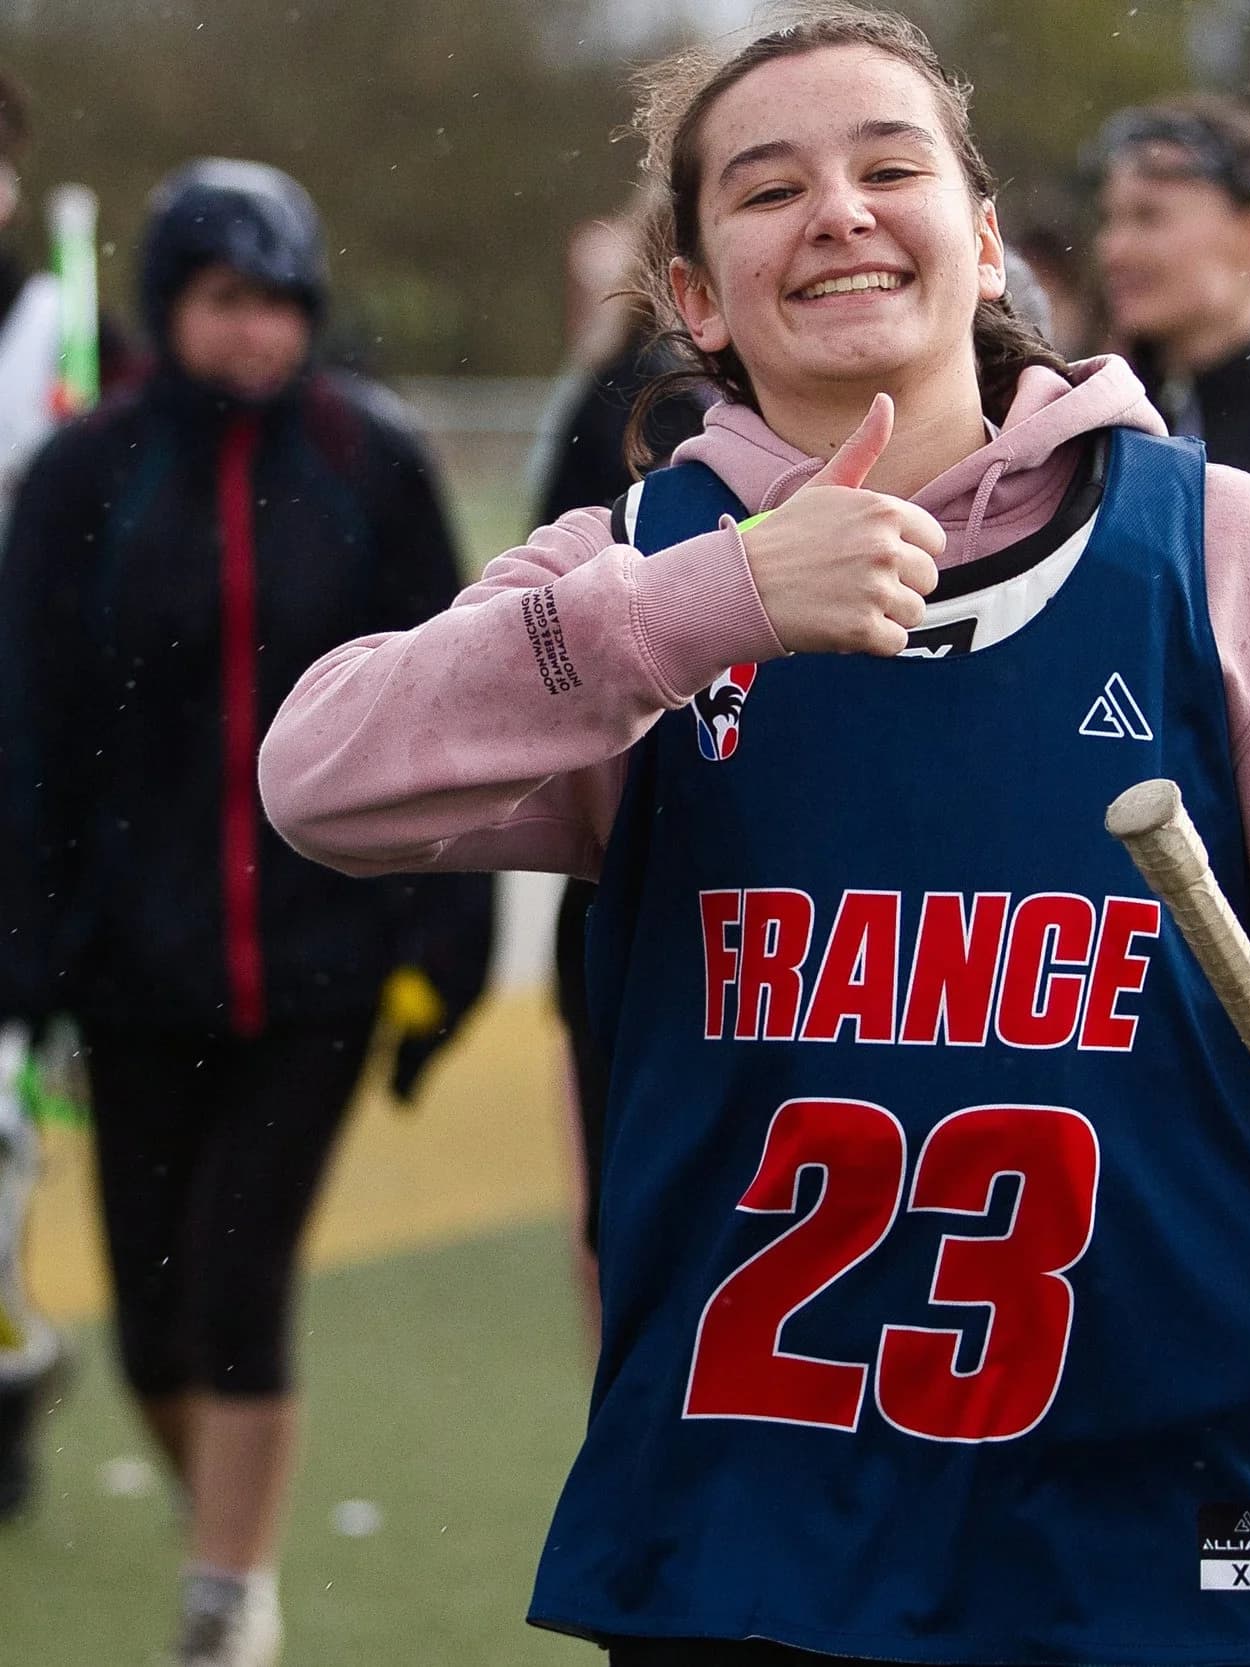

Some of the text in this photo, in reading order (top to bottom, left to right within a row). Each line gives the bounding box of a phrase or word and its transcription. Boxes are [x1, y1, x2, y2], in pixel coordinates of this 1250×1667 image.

[521, 597, 543, 658] WATCHING
[541, 629, 552, 639] &
[551, 615, 560, 625] A
[536, 657, 560, 695] MOON
[543, 639, 563, 676] AMBER
[563, 662, 583, 688] INTO
[555, 677, 570, 692] OF
[699, 887, 1161, 1052] FRANCE
[681, 1097, 1100, 1443] 23
